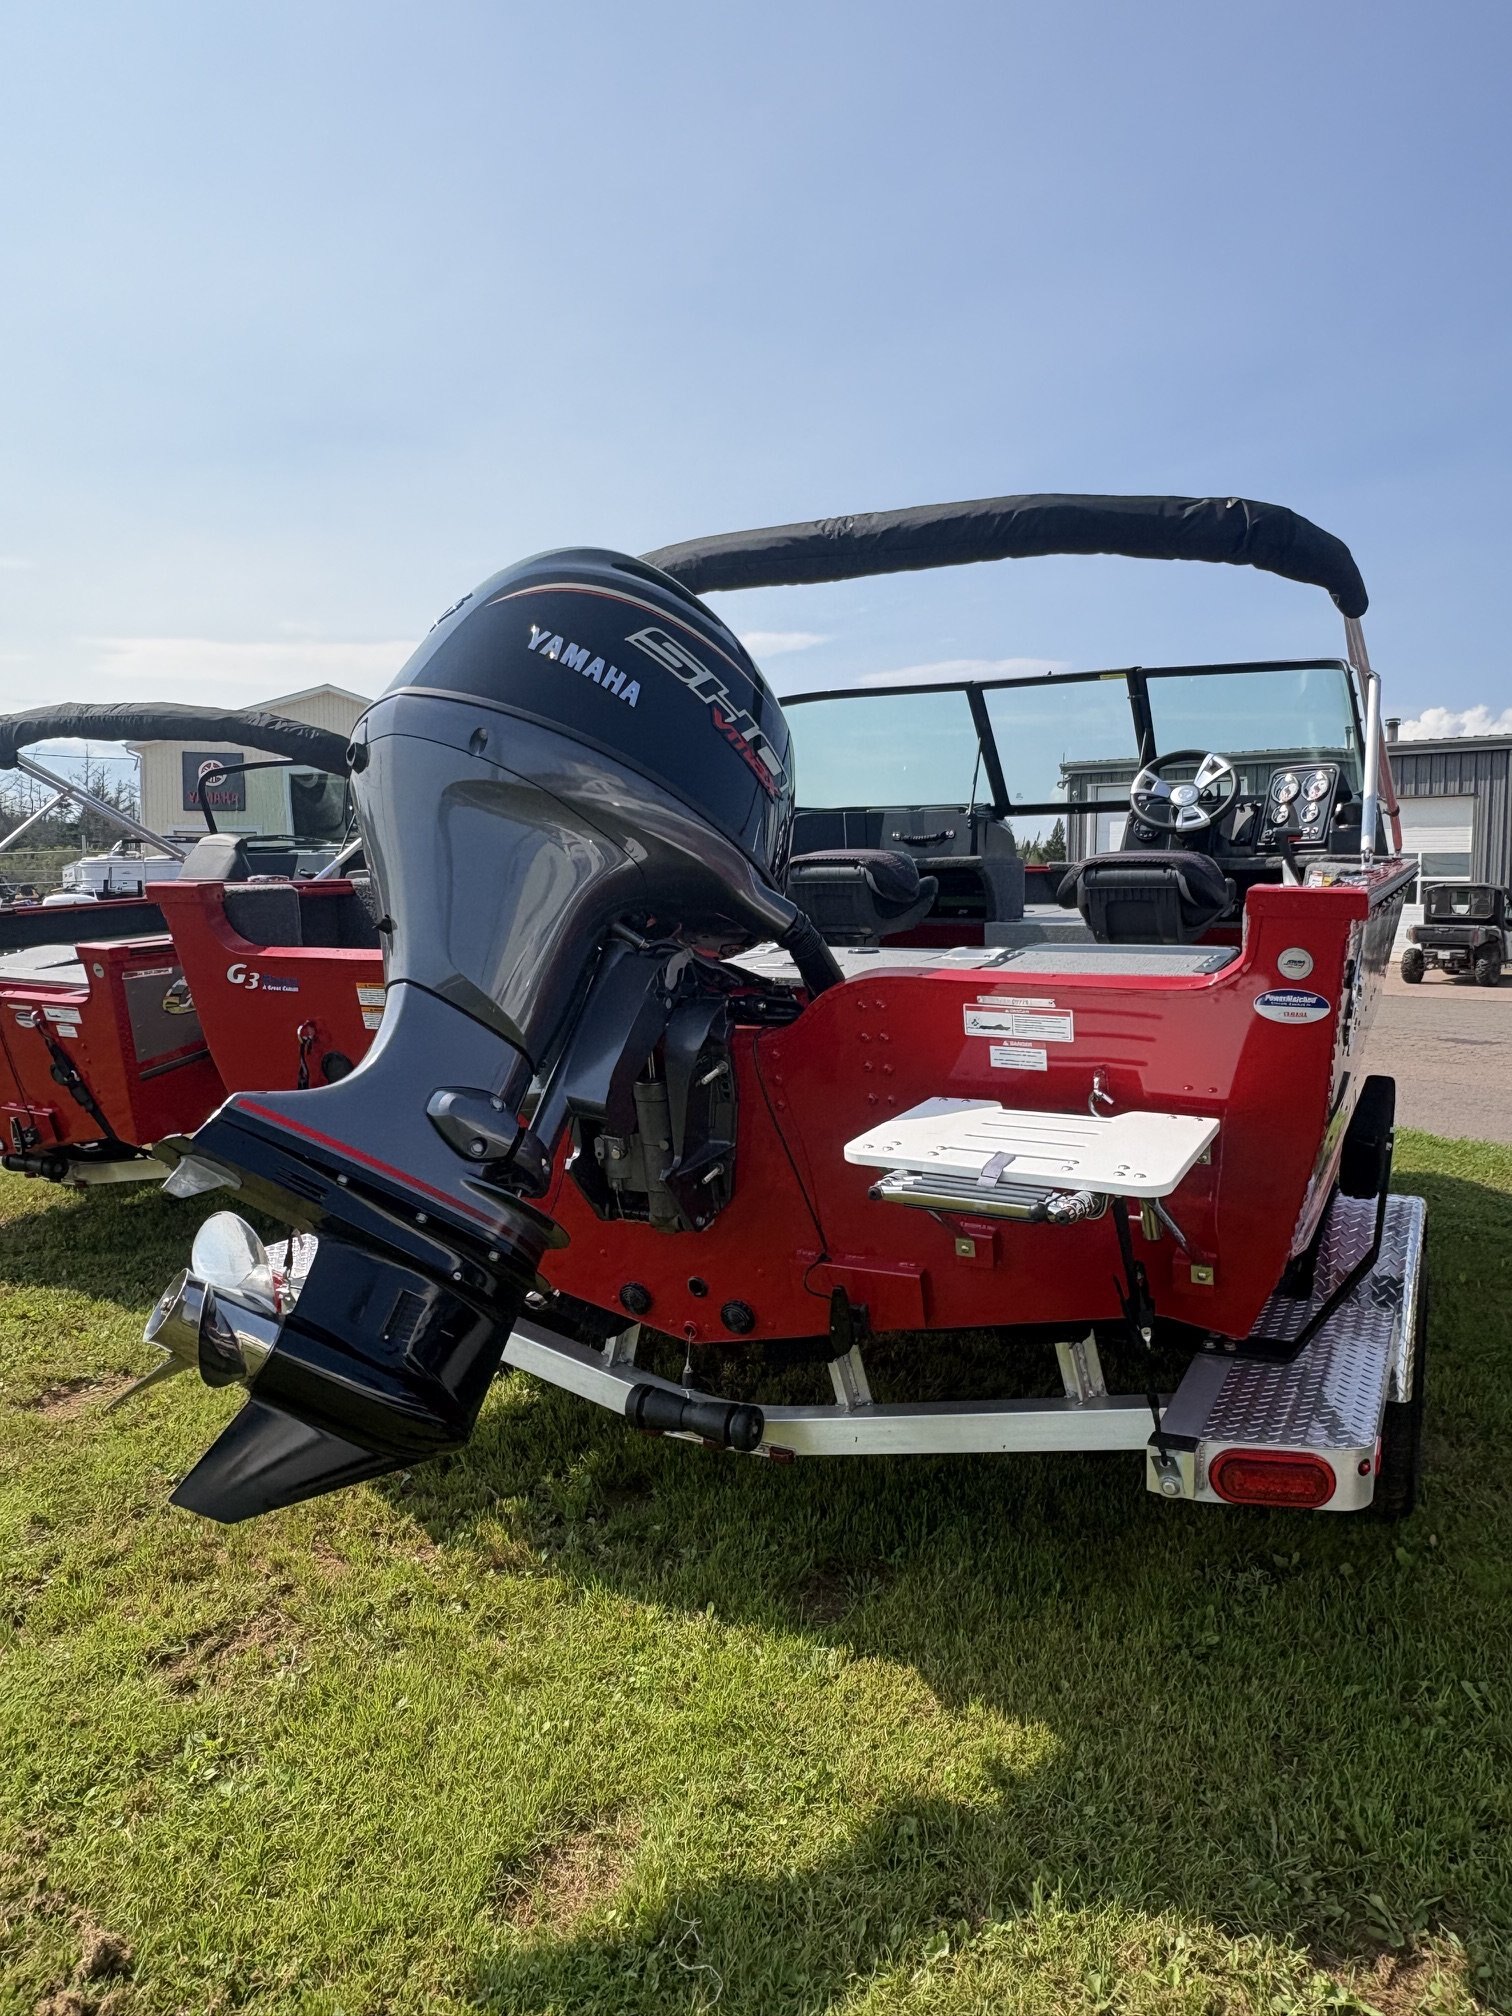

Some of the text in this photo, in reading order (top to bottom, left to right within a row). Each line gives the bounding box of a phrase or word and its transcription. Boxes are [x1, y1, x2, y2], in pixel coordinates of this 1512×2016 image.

[527, 624, 640, 708] YAMAHA
[187, 791, 240, 804] YMAHA
[226, 963, 260, 990] G3
